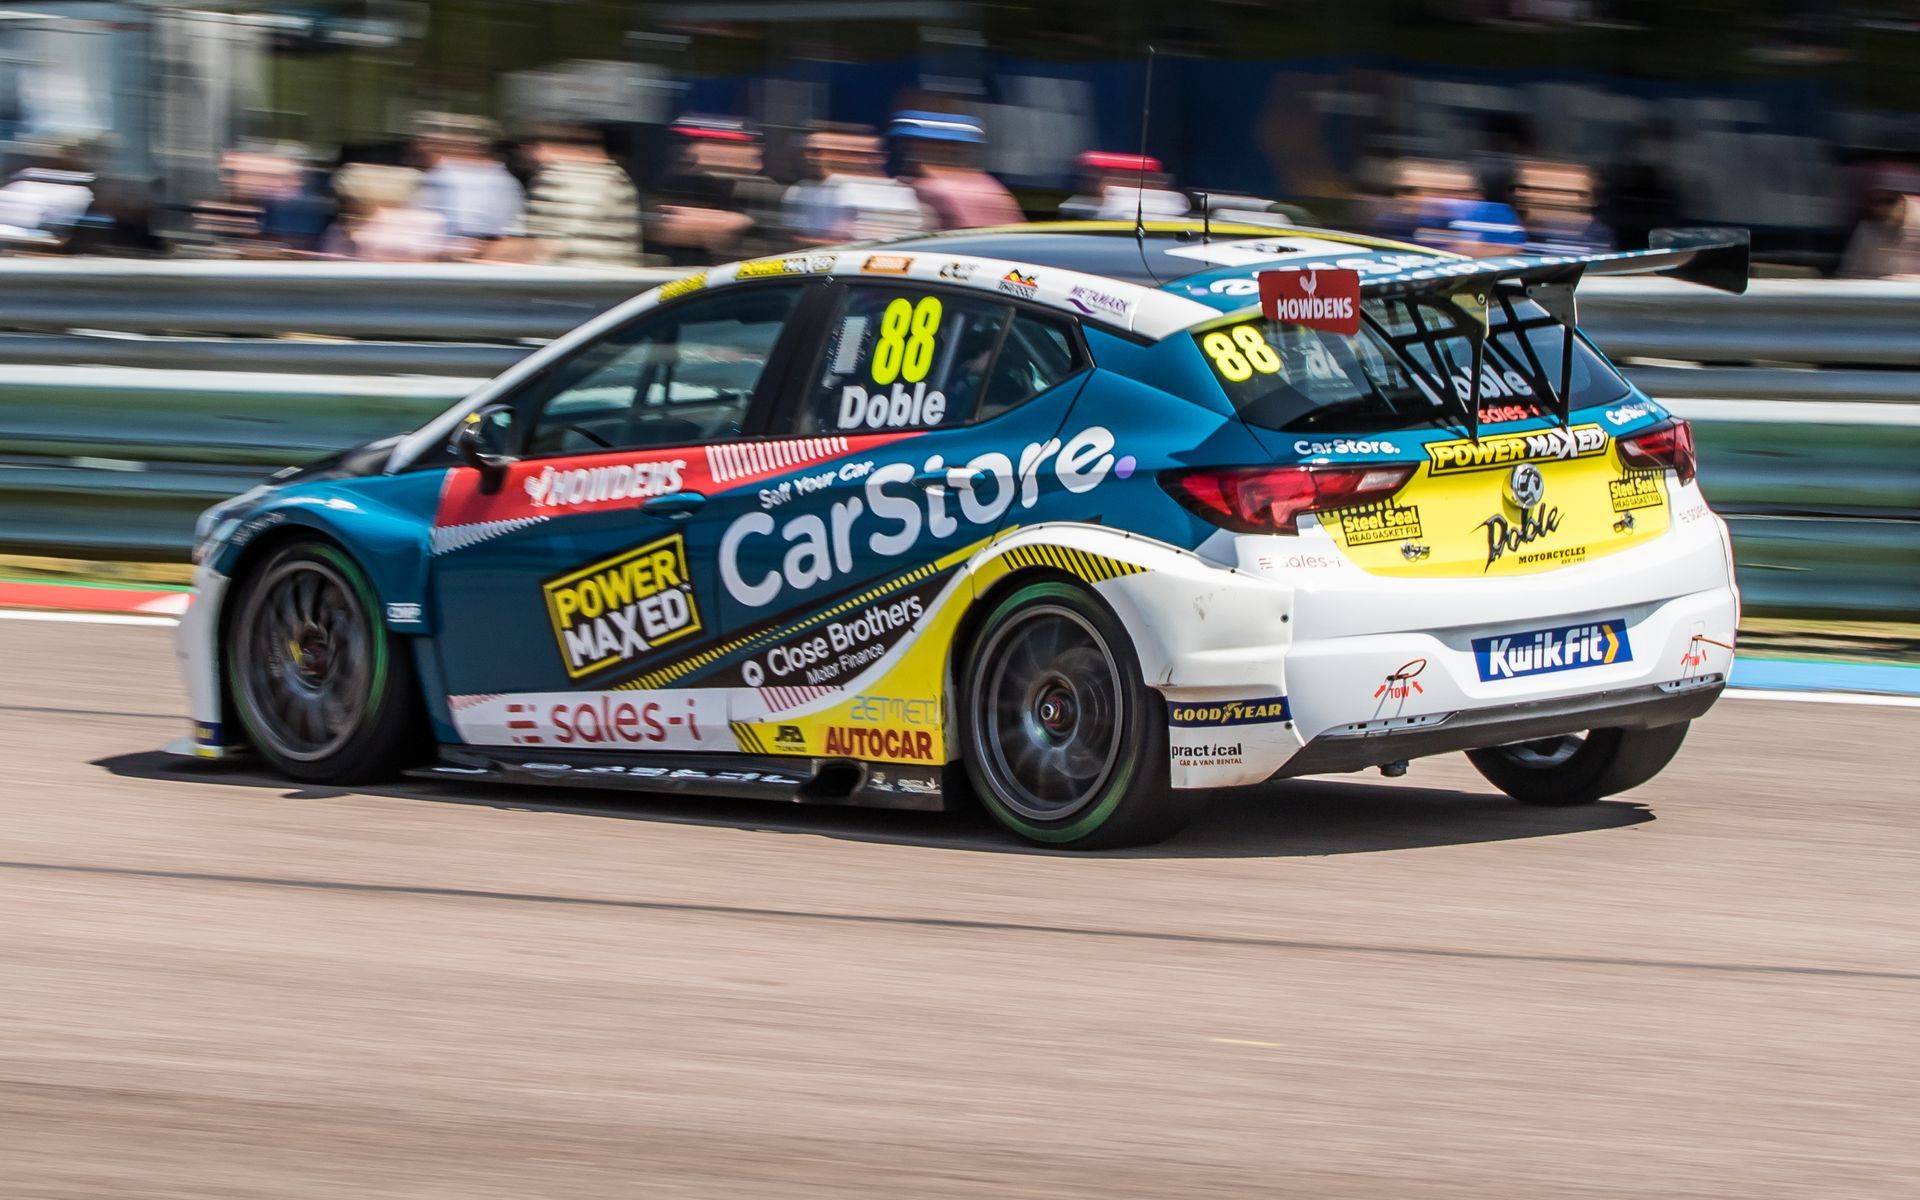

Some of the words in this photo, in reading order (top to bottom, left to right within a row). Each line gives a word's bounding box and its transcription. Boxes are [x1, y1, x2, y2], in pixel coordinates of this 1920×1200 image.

[1277, 297, 1354, 320] HOWDENS
[870, 296, 943, 385] 88
[1203, 325, 1281, 382] 88
[837, 381, 946, 430] Doble
[1478, 404, 1539, 424] sales-i
[1436, 438, 1526, 468] POWER
[1526, 427, 1605, 458] MAXED
[550, 460, 687, 506] HOWDENS
[793, 471, 837, 496] Your
[1610, 479, 1636, 499] Steel
[1635, 475, 1658, 496] Seal
[1343, 511, 1384, 533] Steel
[1385, 507, 1419, 529] Seal
[1349, 532, 1372, 544] HEAD
[1373, 528, 1404, 541] GASKET
[1405, 524, 1420, 536] FIX
[1471, 501, 1565, 573] Doble
[1519, 546, 1586, 564] MOTORCYCLES
[553, 549, 682, 628] POWER
[563, 588, 691, 667] MAXED
[766, 636, 829, 676] Close
[826, 595, 923, 653] Brothers
[805, 663, 840, 686] Motor
[838, 643, 885, 672] Finance
[1389, 686, 1410, 700] TOW
[549, 697, 702, 744] sales-i
[825, 726, 934, 760] AUTOCAR
[1171, 743, 1242, 759] practical
[1199, 758, 1215, 766] VAN
[1216, 757, 1242, 766] RENTAL
